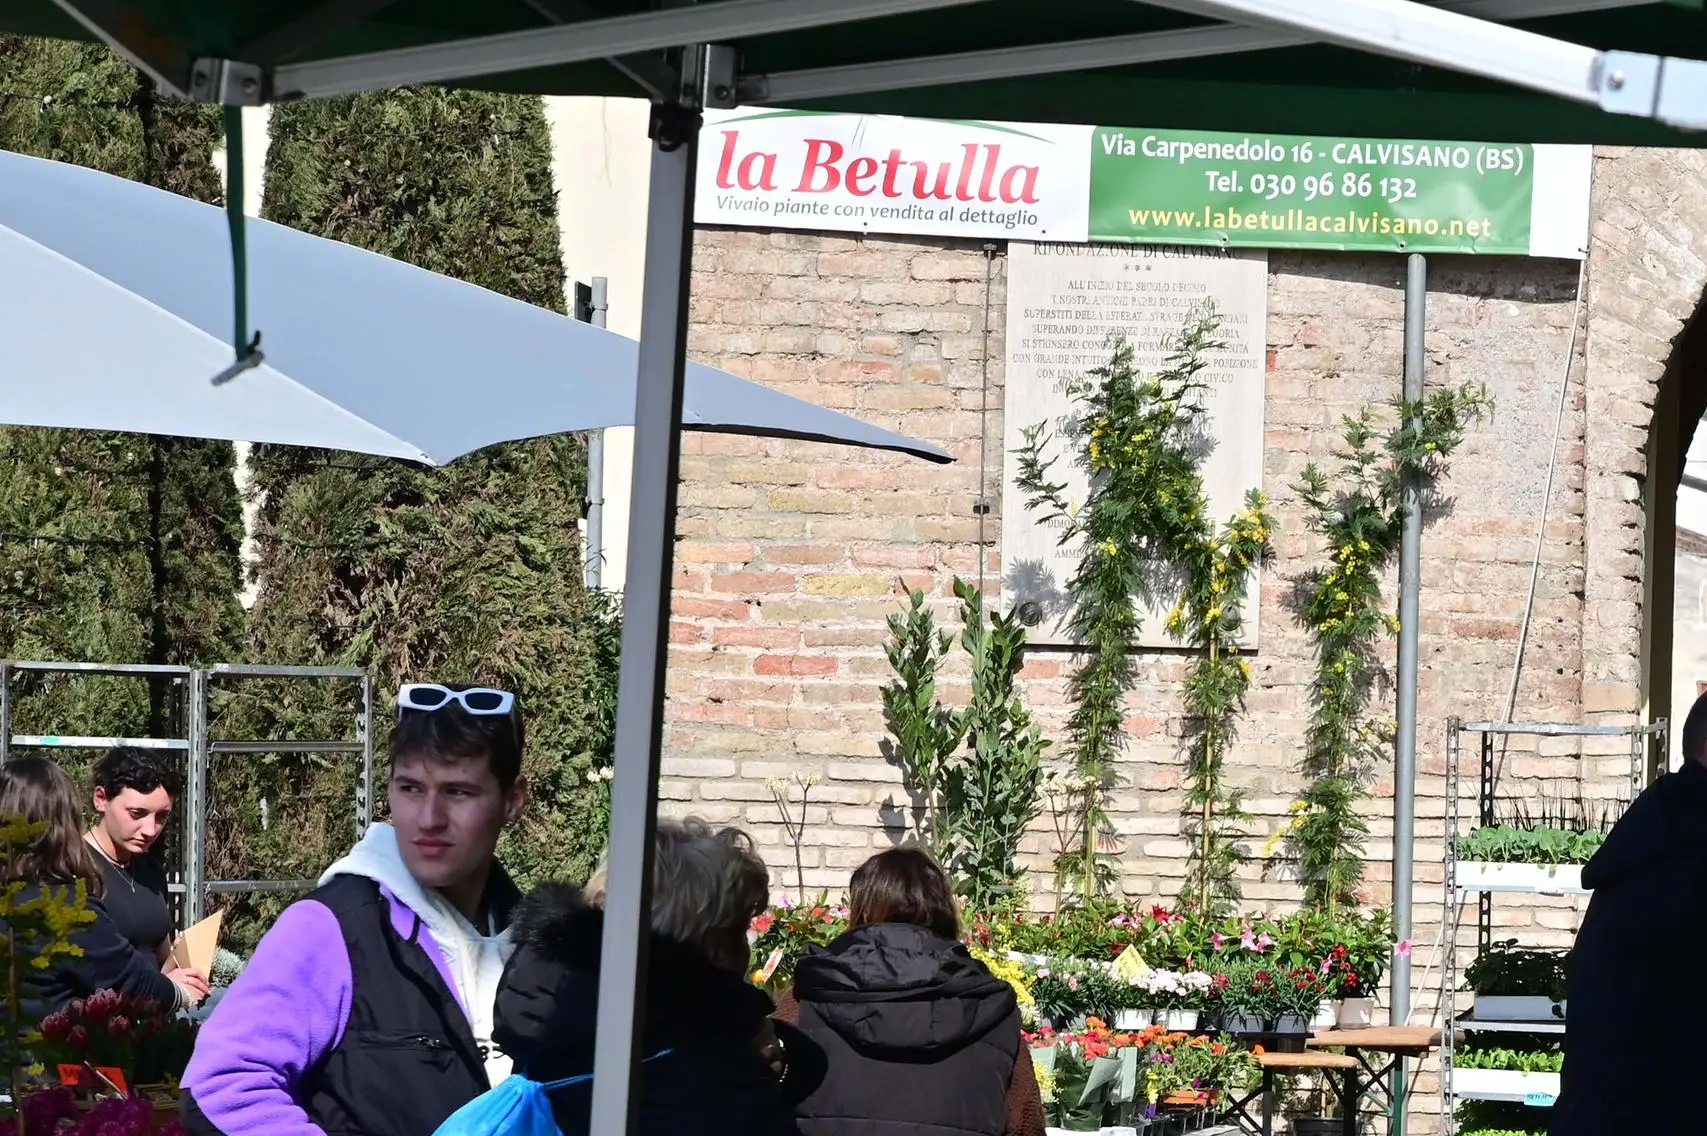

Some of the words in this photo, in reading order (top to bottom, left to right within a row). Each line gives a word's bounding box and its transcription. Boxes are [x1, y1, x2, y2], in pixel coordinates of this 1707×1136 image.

[715, 130, 778, 191] la
[791, 138, 1041, 205] Betulla
[1101, 133, 1136, 156] Via
[1142, 135, 1285, 165] Carpenedolo
[1290, 141, 1313, 163] 16
[1332, 143, 1470, 169] CALVISANO
[1476, 145, 1524, 176] (BS)
[1205, 170, 1244, 193] Tel.
[1250, 173, 1296, 200] 030
[1303, 172, 1335, 201] 96
[1341, 172, 1372, 198] 86
[1379, 177, 1417, 204] 132
[716, 195, 770, 213] Vivaio
[773, 199, 829, 218] piante
[834, 203, 866, 218] con
[870, 202, 934, 222] vendita
[938, 207, 954, 223] al
[959, 207, 1038, 230] dettaglio
[1128, 206, 1491, 237] www.labetullacalvisano.net
